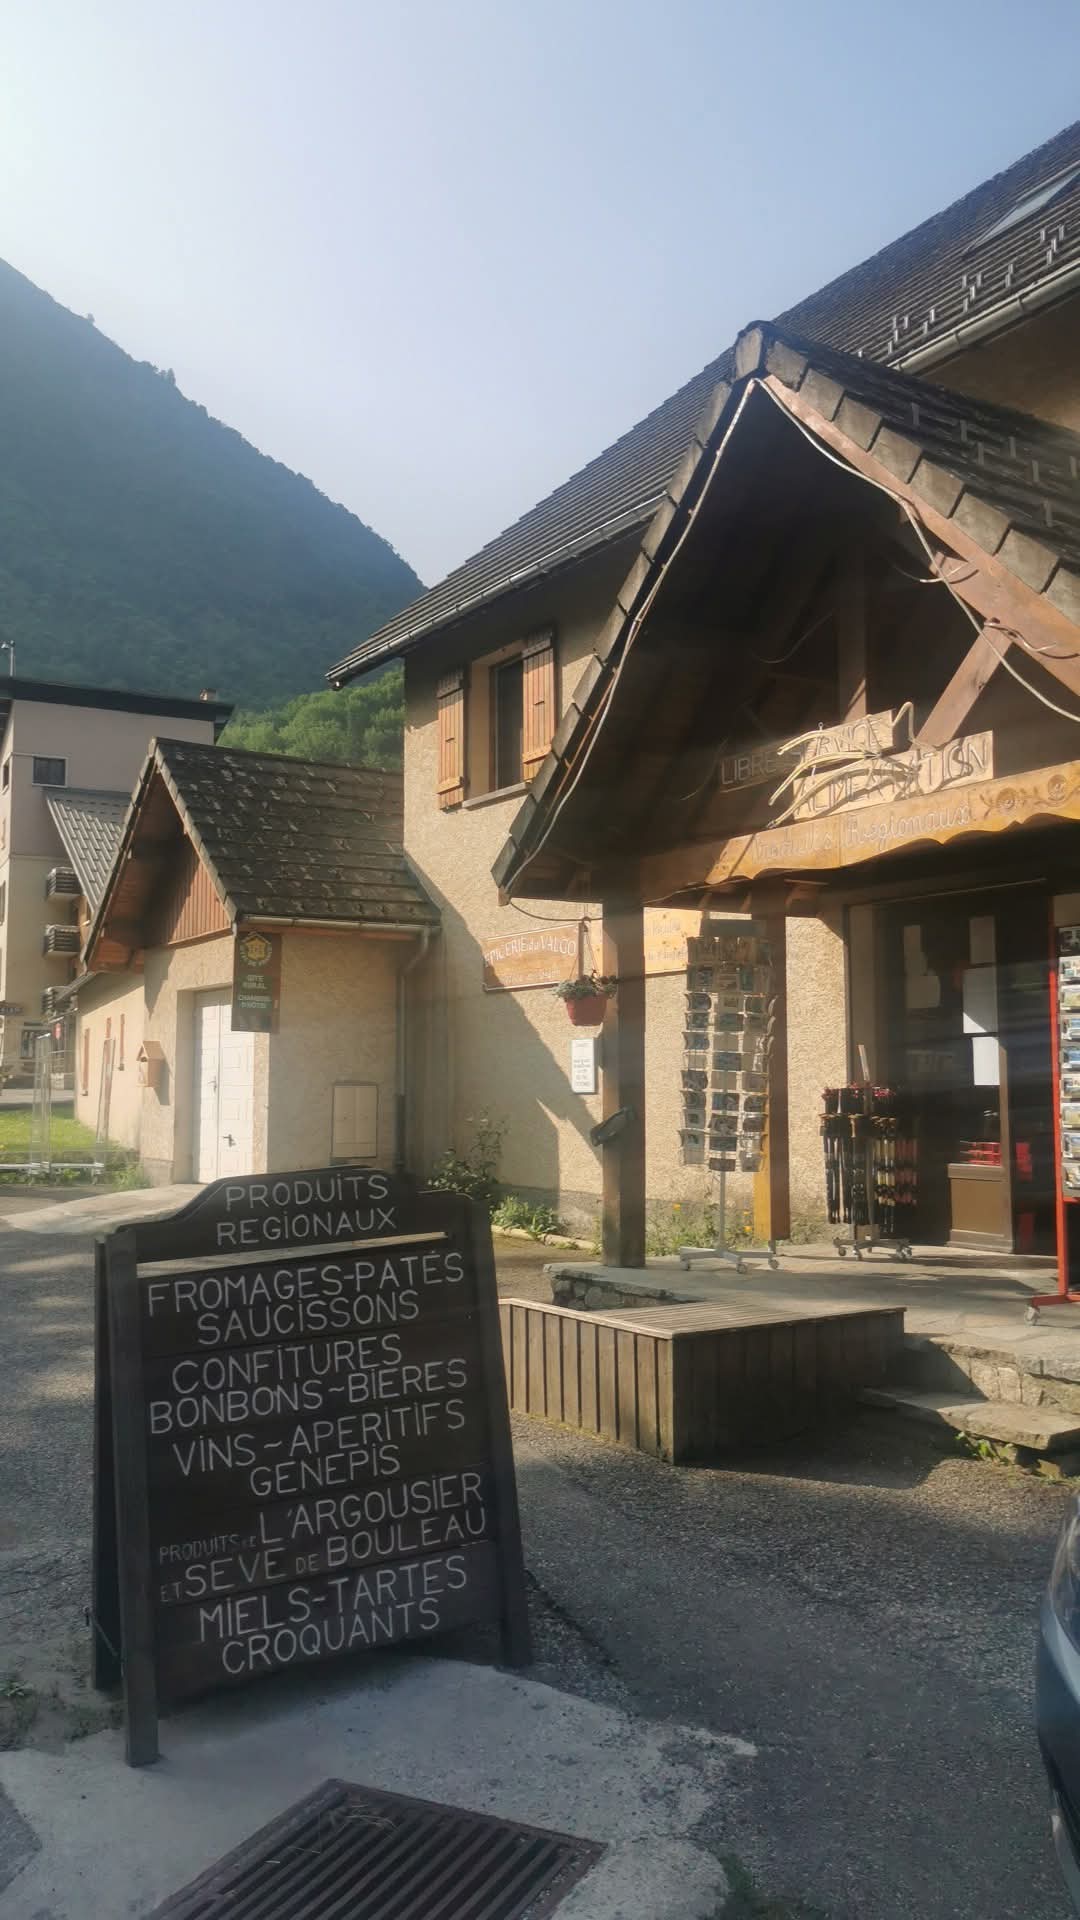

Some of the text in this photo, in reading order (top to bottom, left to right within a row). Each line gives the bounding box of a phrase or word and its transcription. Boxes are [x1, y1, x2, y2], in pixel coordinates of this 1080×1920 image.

[721, 750, 777, 785] LIBRE
[225, 1173, 389, 1212] PRODUITS
[215, 1206, 398, 1247] REGIONAUX
[197, 1289, 420, 1346] SAUCISSONS
[171, 1333, 402, 1395] CONFITURES
[250, 1443, 401, 1497] GENEPIS
[259, 1472, 484, 1545] L'ARGOUSIER
[160, 1506, 487, 1602] ET SEVE DE BOULEAU
[221, 1597, 441, 1675] CROQUANTS
